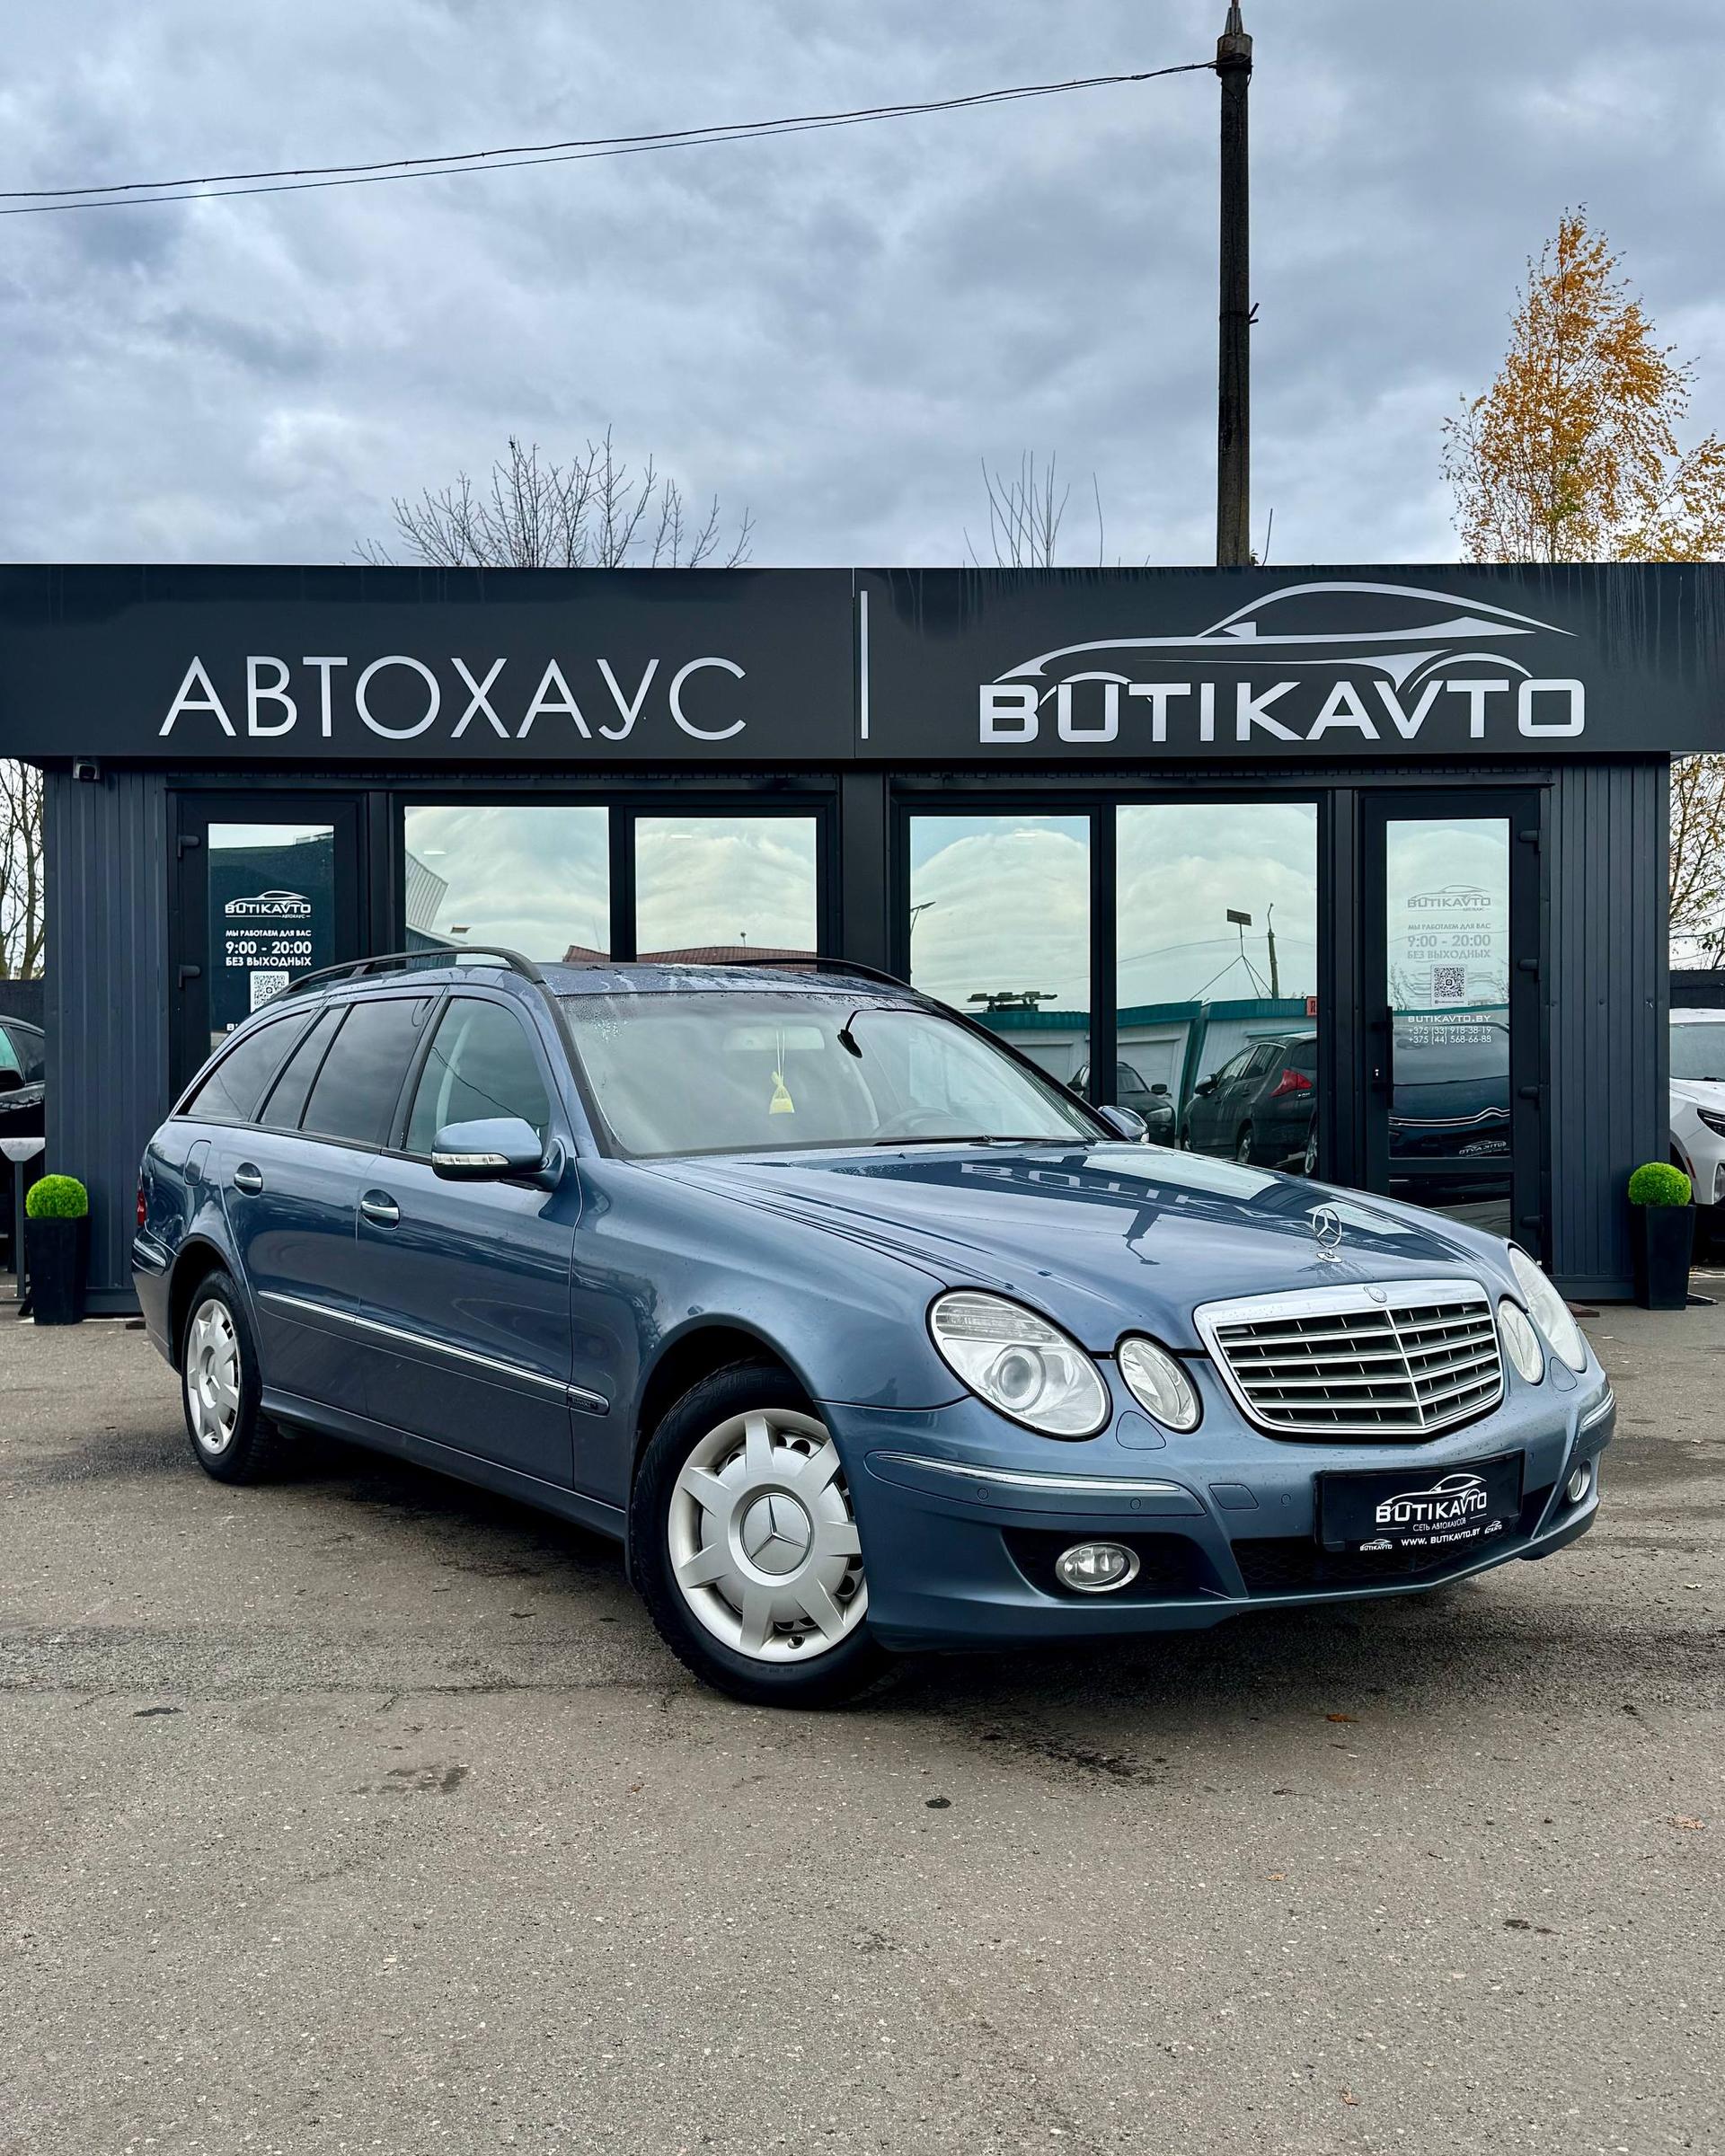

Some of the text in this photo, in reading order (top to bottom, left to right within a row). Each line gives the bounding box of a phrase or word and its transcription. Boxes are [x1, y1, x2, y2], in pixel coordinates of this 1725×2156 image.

[158, 656, 747, 740] АВТОХАУС
[979, 678, 1586, 743] BUTIKAVTO
[1408, 897, 1491, 907] BUTIKAVTO
[225, 904, 312, 914] BUTIKAVTO
[1408, 935, 1438, 947] 9:00
[1452, 934, 1491, 947] 20:00
[226, 941, 257, 954] 9:00
[271, 941, 312, 954] 20:00
[1408, 950, 1491, 959] БЕЗ ВЫХОДНЫХ
[226, 957, 312, 968] БЕЗ ВЫХОДНЫХ
[1409, 1026, 1491, 1036] +375 (33) 918-38-19
[1409, 1035, 1491, 1045] +375 (44) 568-66-88
[1376, 1492, 1487, 1523] BUTIKAVTO
[1412, 1524, 1430, 1532] СЕТЬ
[1402, 1537, 1428, 1546] WWW.
[1430, 1527, 1481, 1544] BUTIKAVTO.BY
